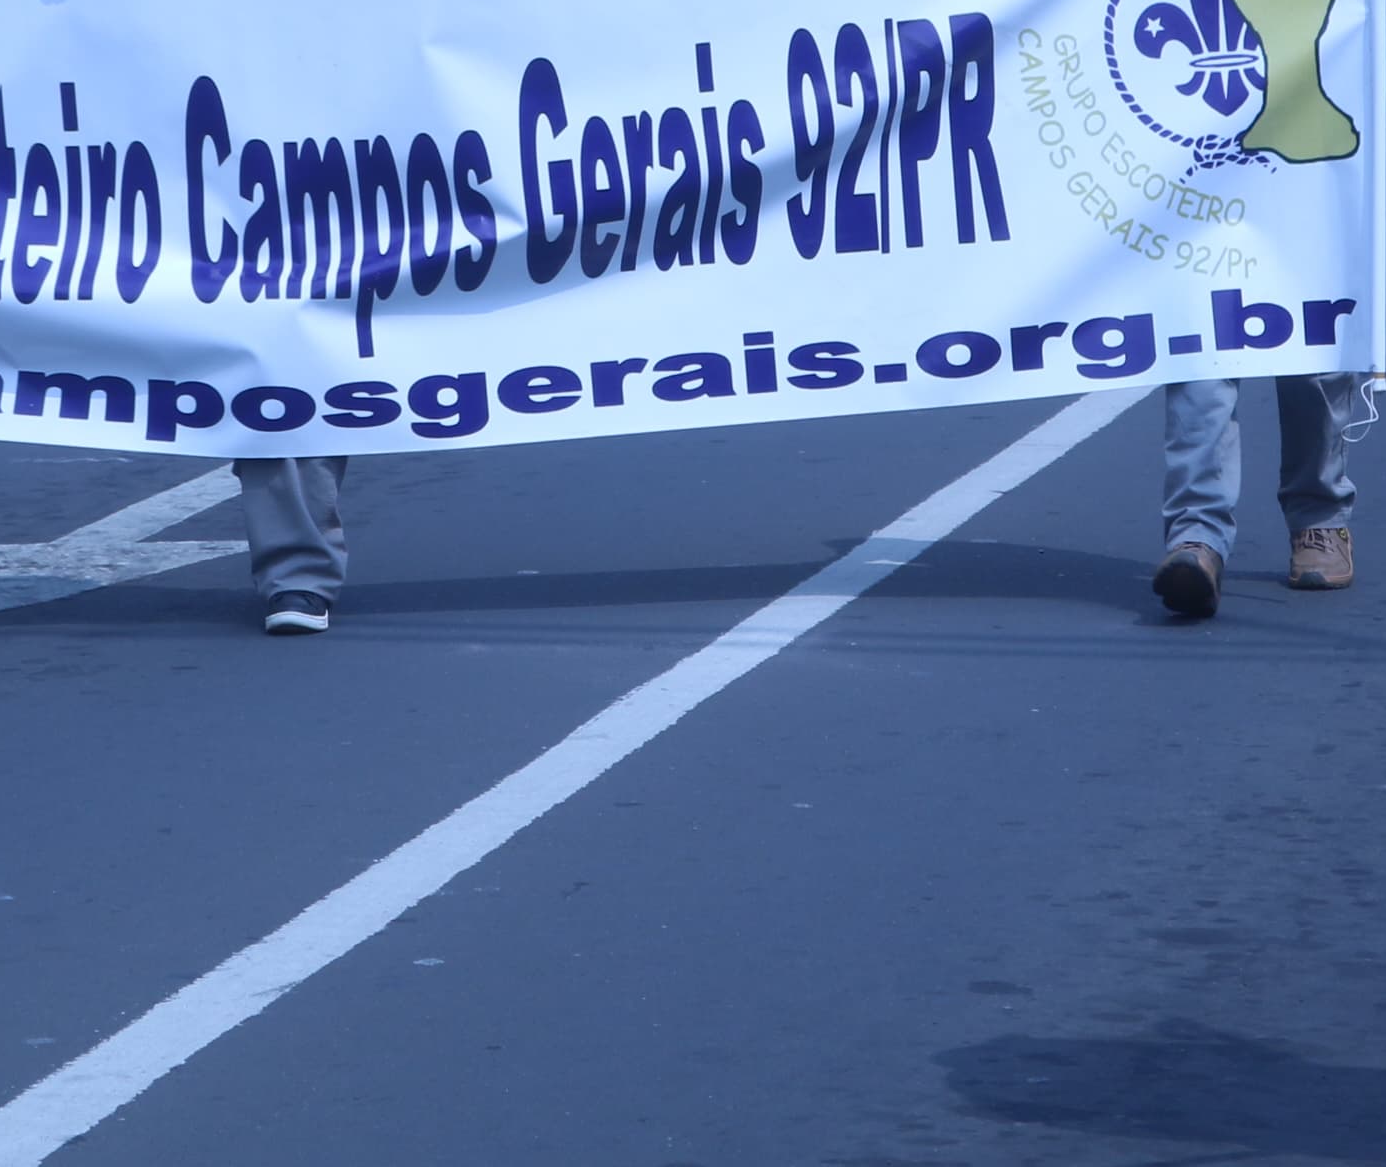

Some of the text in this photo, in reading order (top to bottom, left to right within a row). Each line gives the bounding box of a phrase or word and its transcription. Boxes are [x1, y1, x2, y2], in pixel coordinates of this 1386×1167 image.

[185, 75, 499, 359] Campos
[519, 42, 765, 285] Gerais
[786, 12, 1010, 260] 92/PR
[1017, 28, 1077, 170] CAMPOS
[1066, 171, 1170, 261] GERAIS
[1053, 34, 1246, 227] GRUPO ESCOTEIRO
